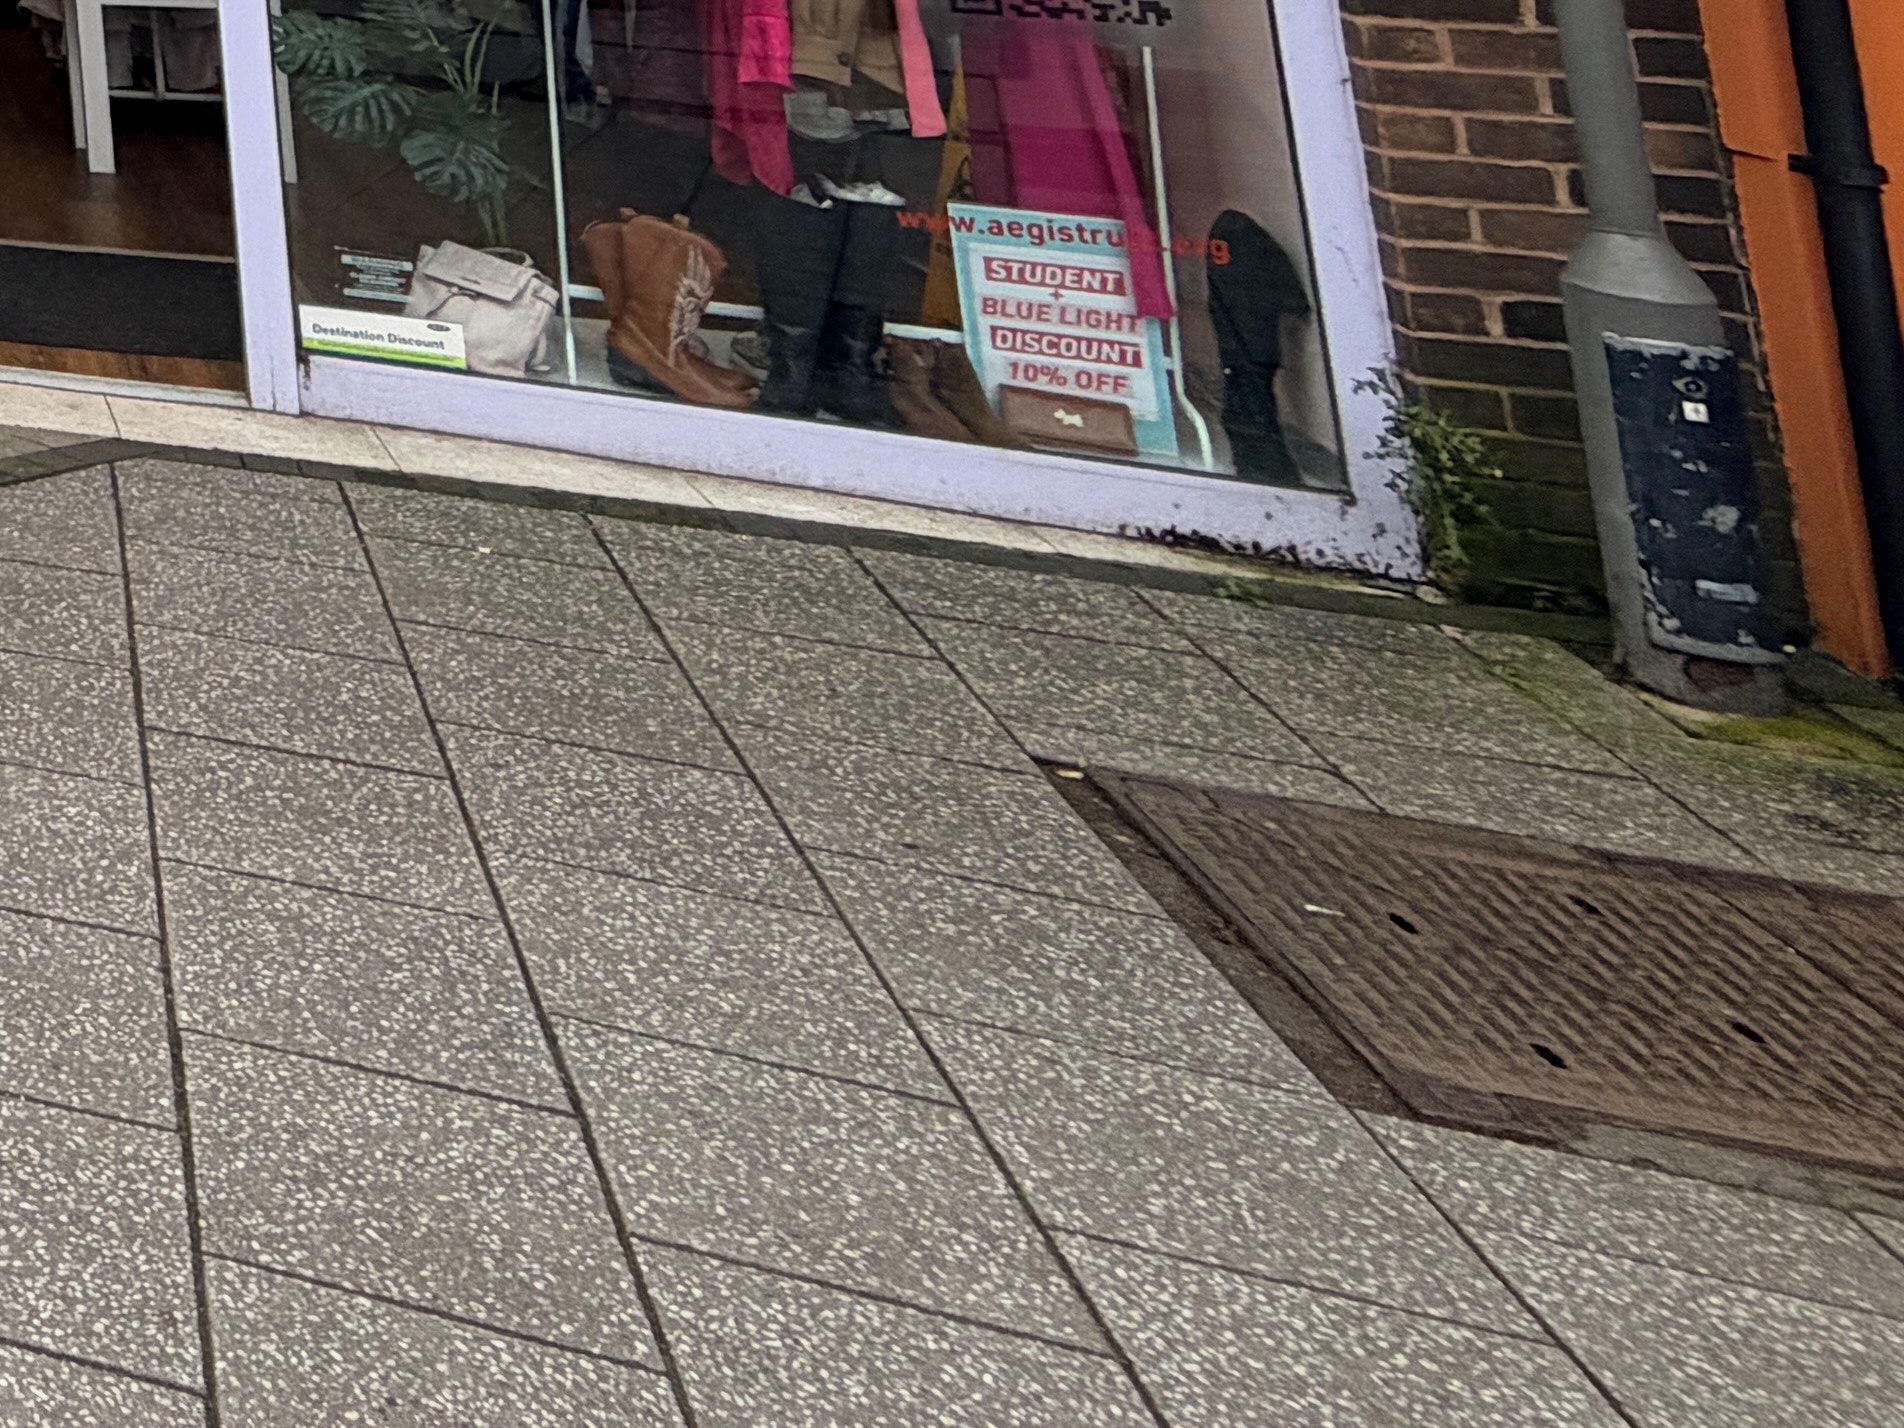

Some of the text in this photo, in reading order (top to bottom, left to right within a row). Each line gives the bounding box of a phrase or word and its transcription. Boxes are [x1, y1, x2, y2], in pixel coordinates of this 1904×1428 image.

[896, 210, 1232, 266] www.aegistru.org
[989, 259, 1121, 292] STUDENT
[981, 297, 1140, 333] BLUE LIGHT
[312, 322, 445, 350] Destination Discount
[995, 329, 1141, 365] DISCOUNT
[1009, 361, 1130, 394] 10% OFF
